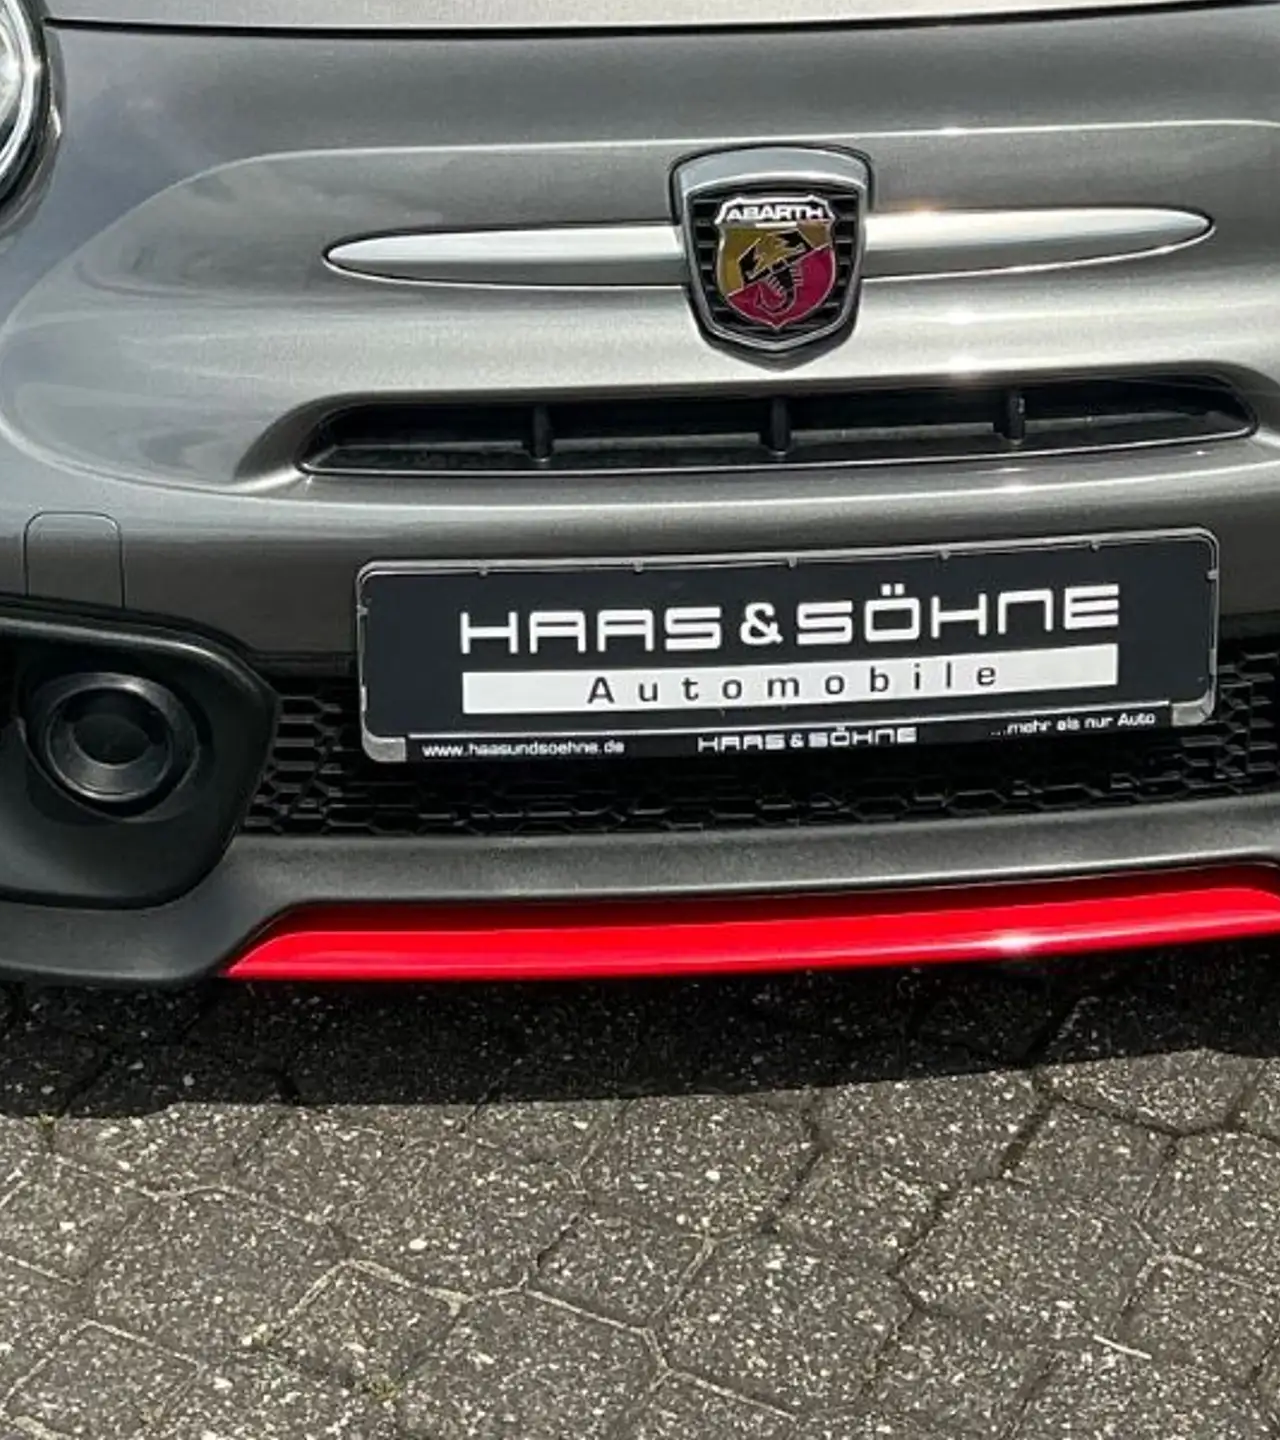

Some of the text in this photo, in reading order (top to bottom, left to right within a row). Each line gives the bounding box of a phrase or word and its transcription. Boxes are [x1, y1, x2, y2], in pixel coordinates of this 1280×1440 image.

[725, 202, 823, 222] ABARTH
[587, 661, 997, 705] Automobile
[1056, 716, 1081, 732] als
[1084, 717, 1114, 730] nur
[1117, 712, 1157, 727] Auto
[422, 739, 625, 758] www.haasundsoehne.de
